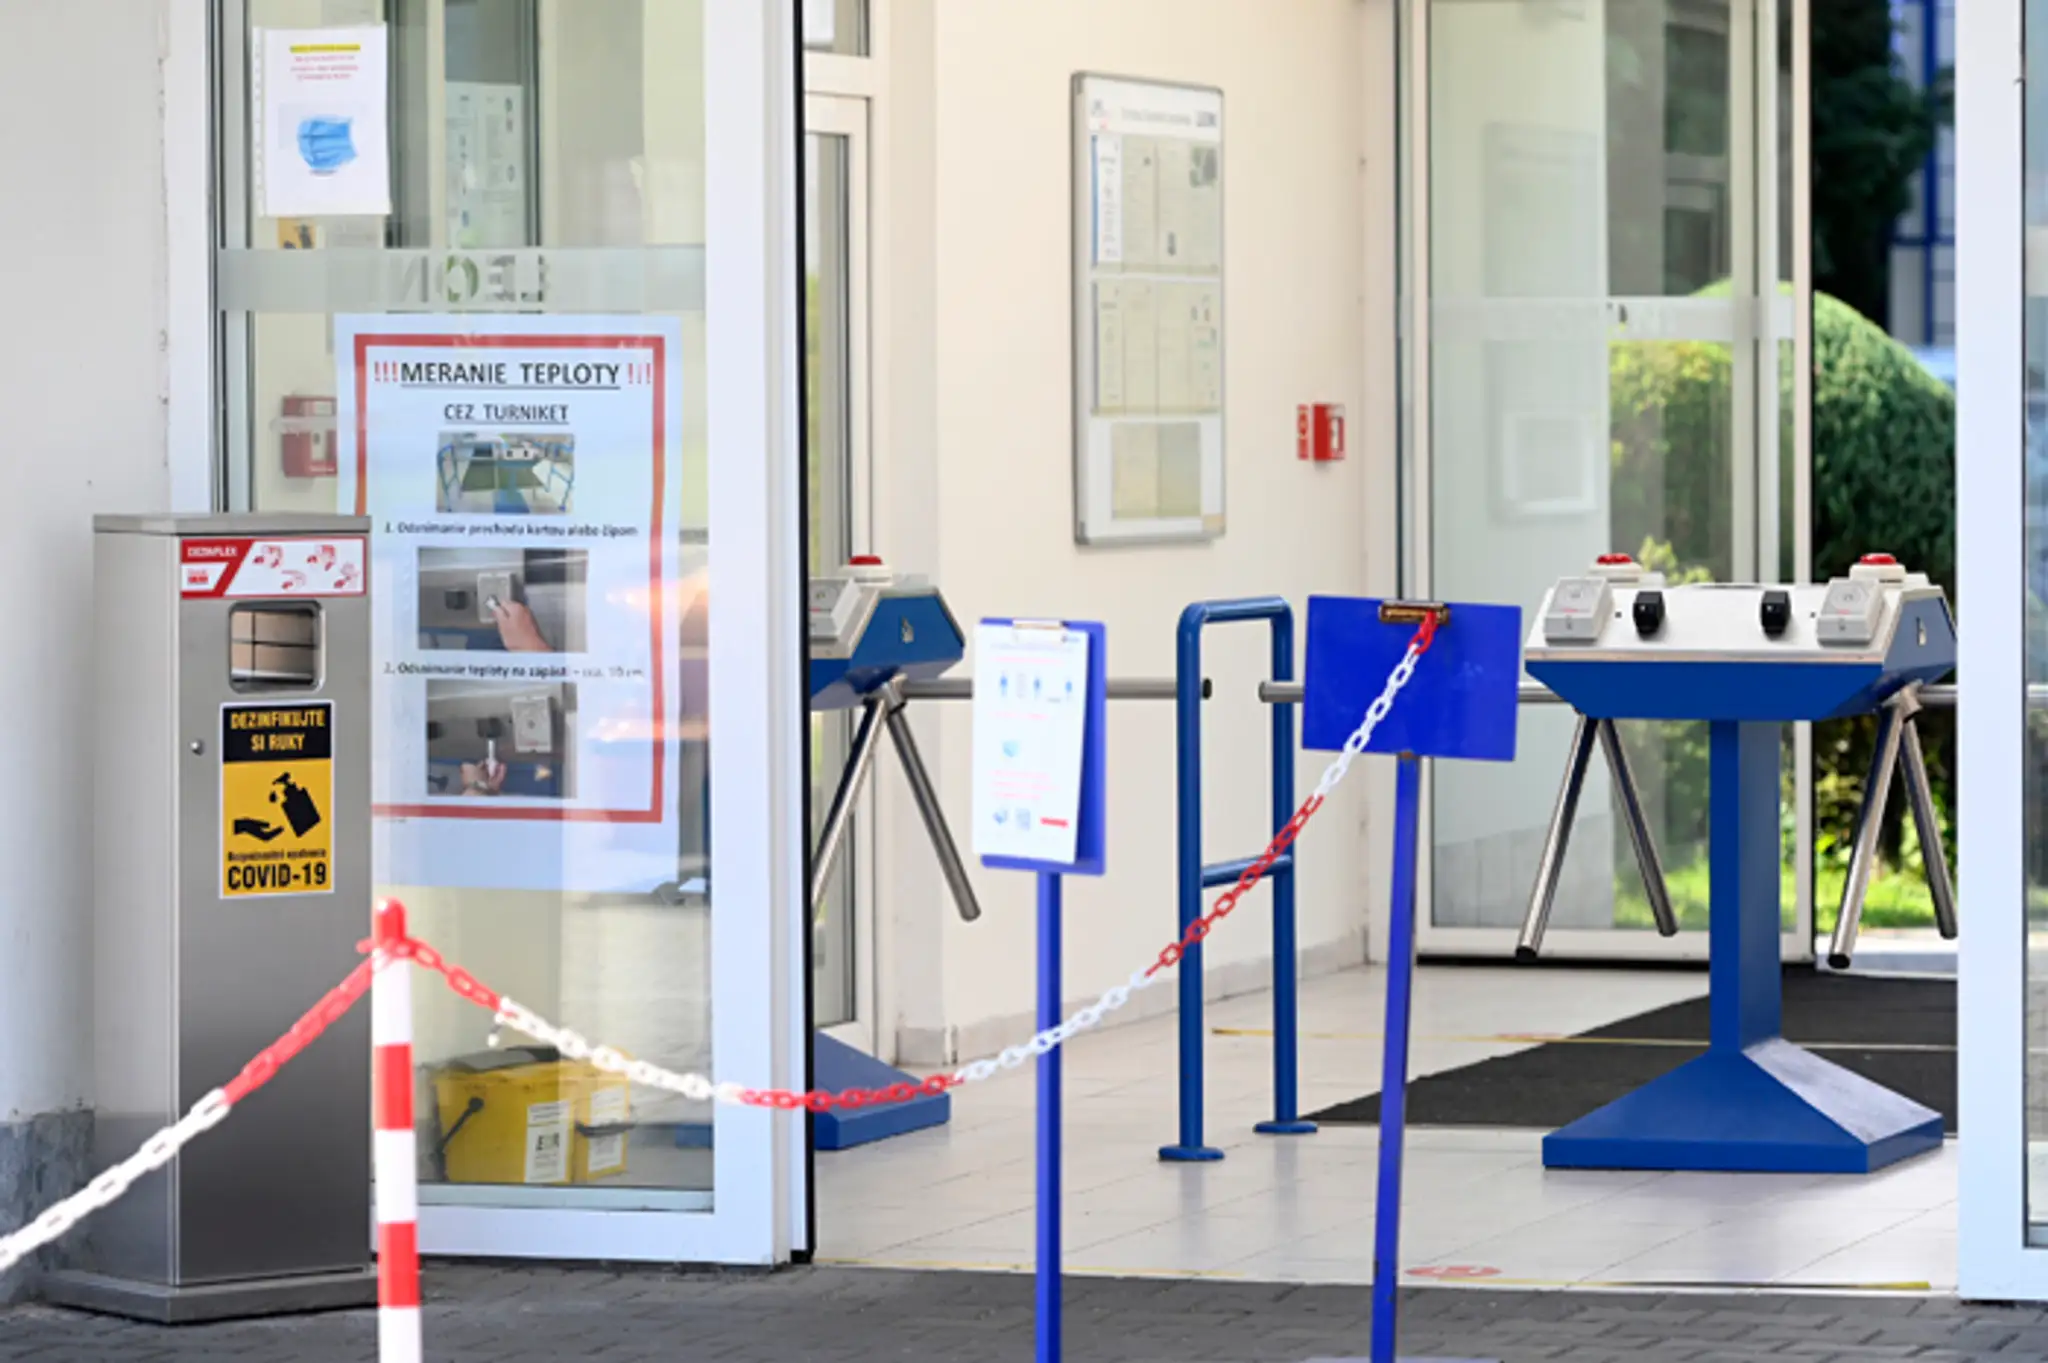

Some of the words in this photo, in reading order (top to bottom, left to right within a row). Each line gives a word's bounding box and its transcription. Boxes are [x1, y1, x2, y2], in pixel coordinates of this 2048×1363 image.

[521, 362, 620, 384] TEPLOTY
[444, 403, 475, 421] CEZ
[484, 404, 569, 422] TURNIKET
[251, 733, 264, 753] SI
[228, 862, 326, 890] COVID-19
